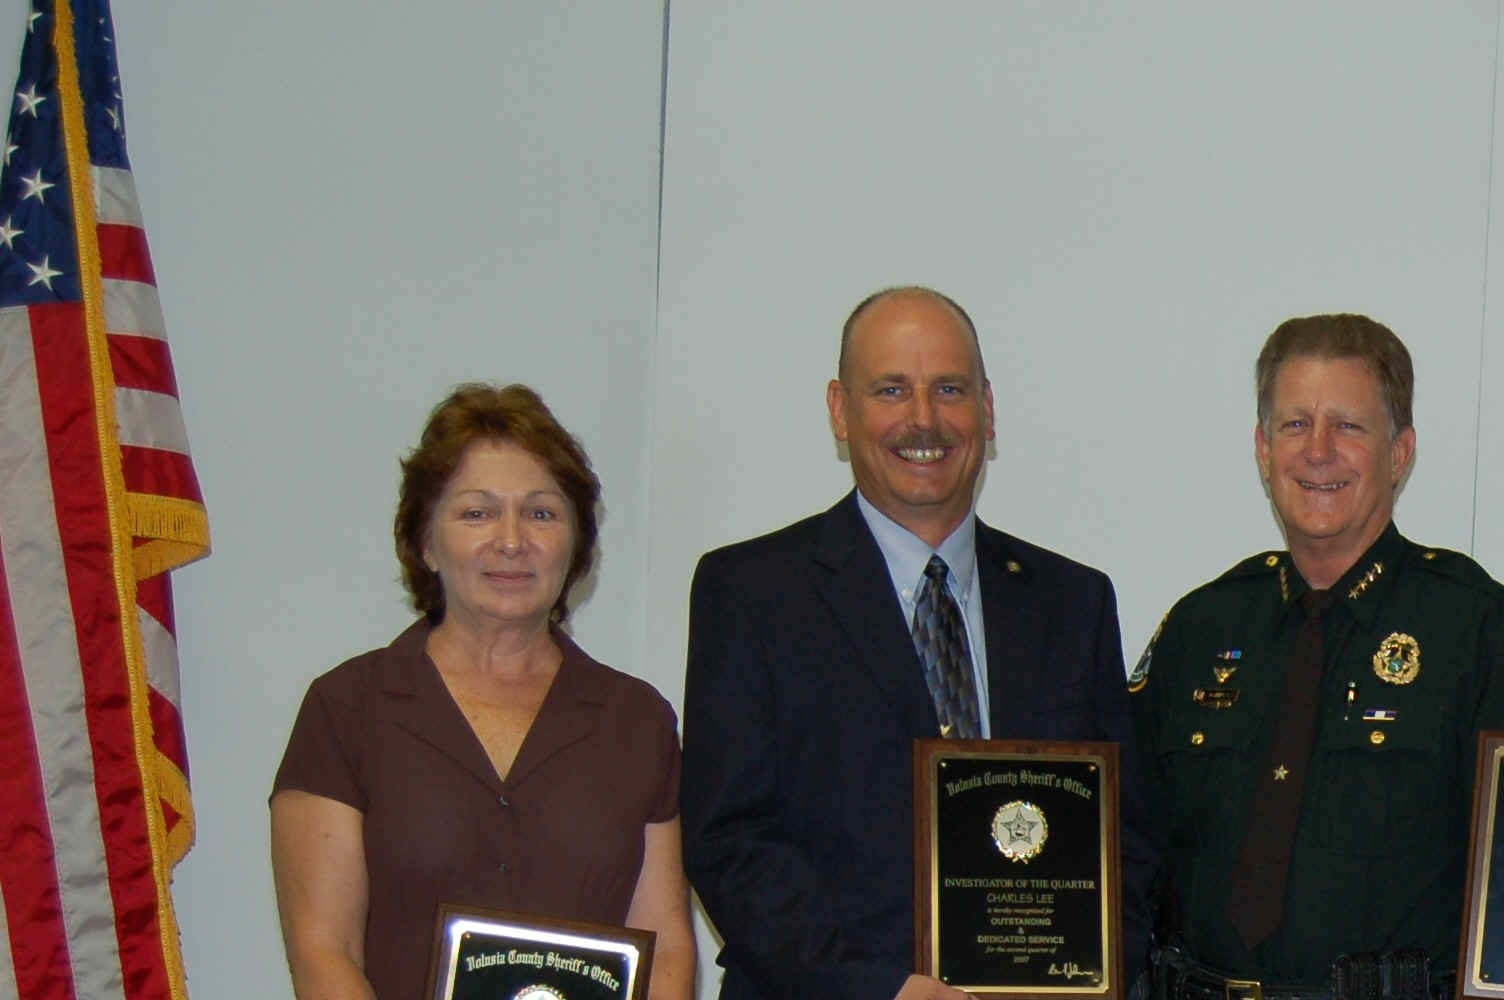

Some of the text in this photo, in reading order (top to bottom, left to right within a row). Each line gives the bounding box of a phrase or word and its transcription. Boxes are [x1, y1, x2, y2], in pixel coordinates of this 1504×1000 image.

[945, 769, 1093, 800] Volusia County Sheriff's Office
[945, 879, 1096, 889] INVESTIGATOR OF THE QUARTER
[987, 893, 1055, 904] CHARLES LEE
[991, 918, 1052, 926] OUTSTANDING
[977, 936, 1064, 944] DEDICATED SERVICE
[467, 949, 620, 992] Volusia County Sheriff's Office
